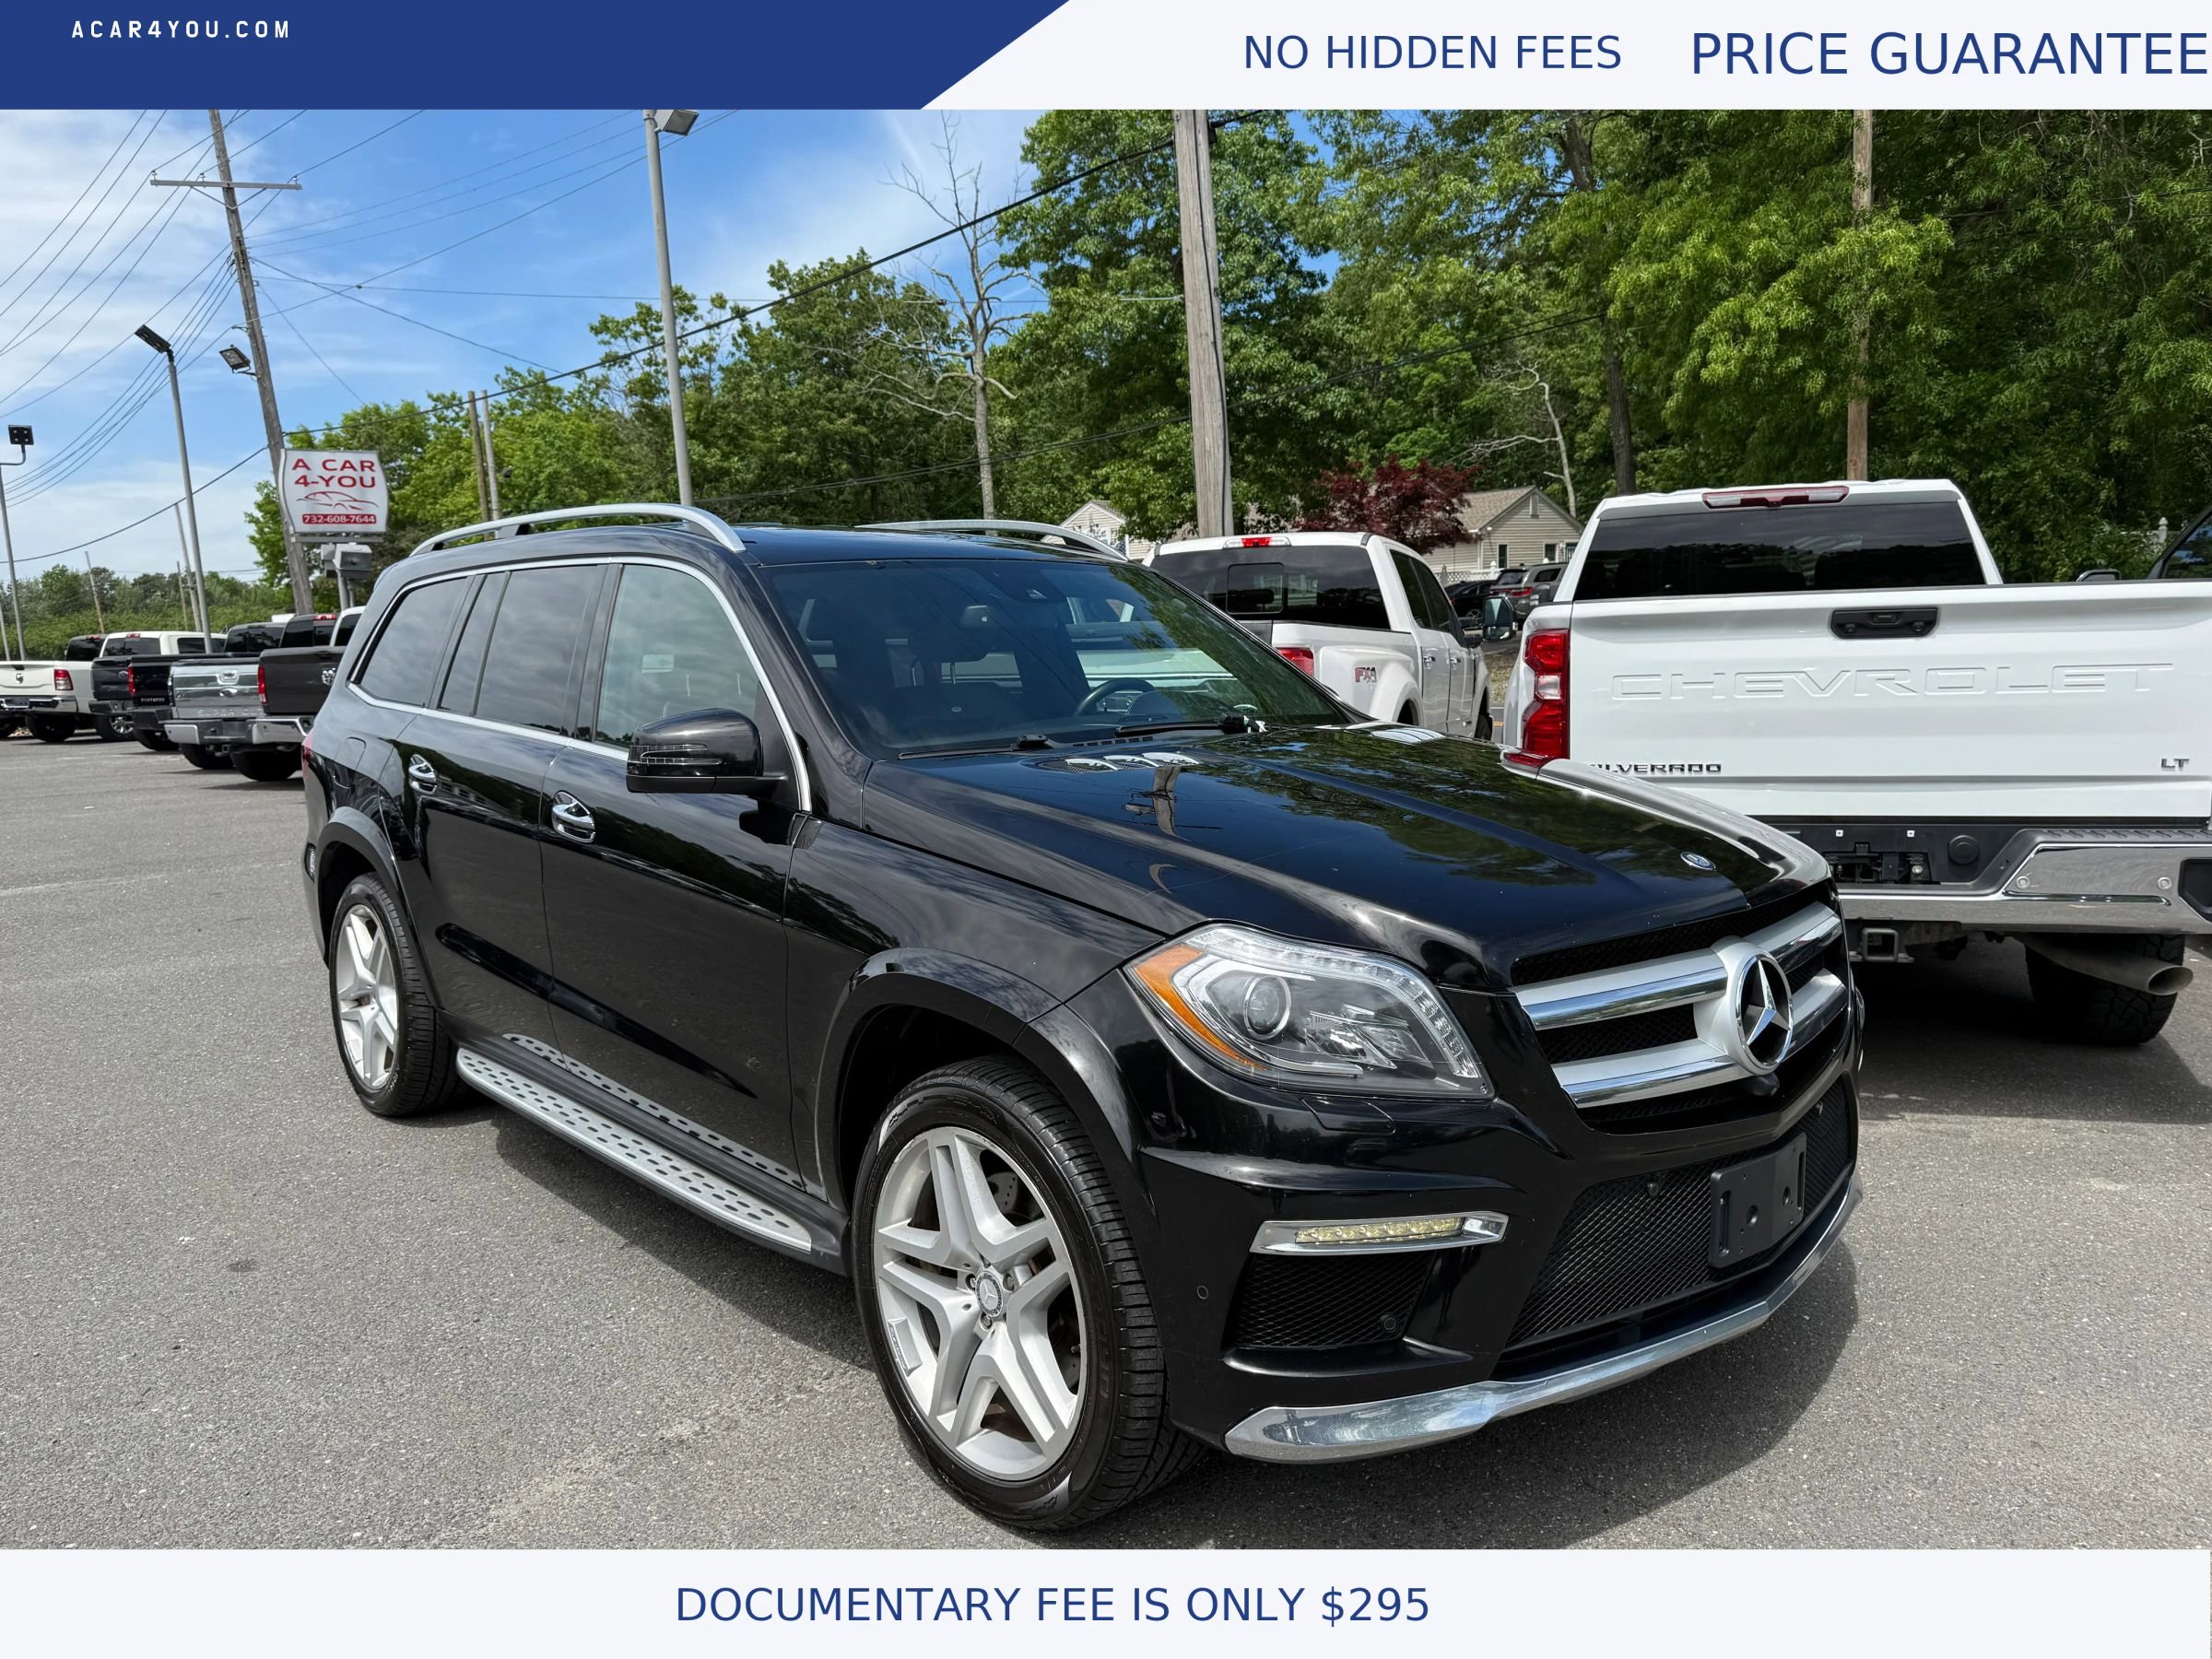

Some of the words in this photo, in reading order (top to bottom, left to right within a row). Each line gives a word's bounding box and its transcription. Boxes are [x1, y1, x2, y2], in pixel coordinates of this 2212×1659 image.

[292, 458, 312, 471] A
[322, 459, 376, 473] CAR
[294, 475, 376, 488] 4-YOU
[303, 514, 376, 524] 732-608-7644
[1612, 663, 2173, 700] CHEVROLET
[2160, 758, 2191, 769] LT
